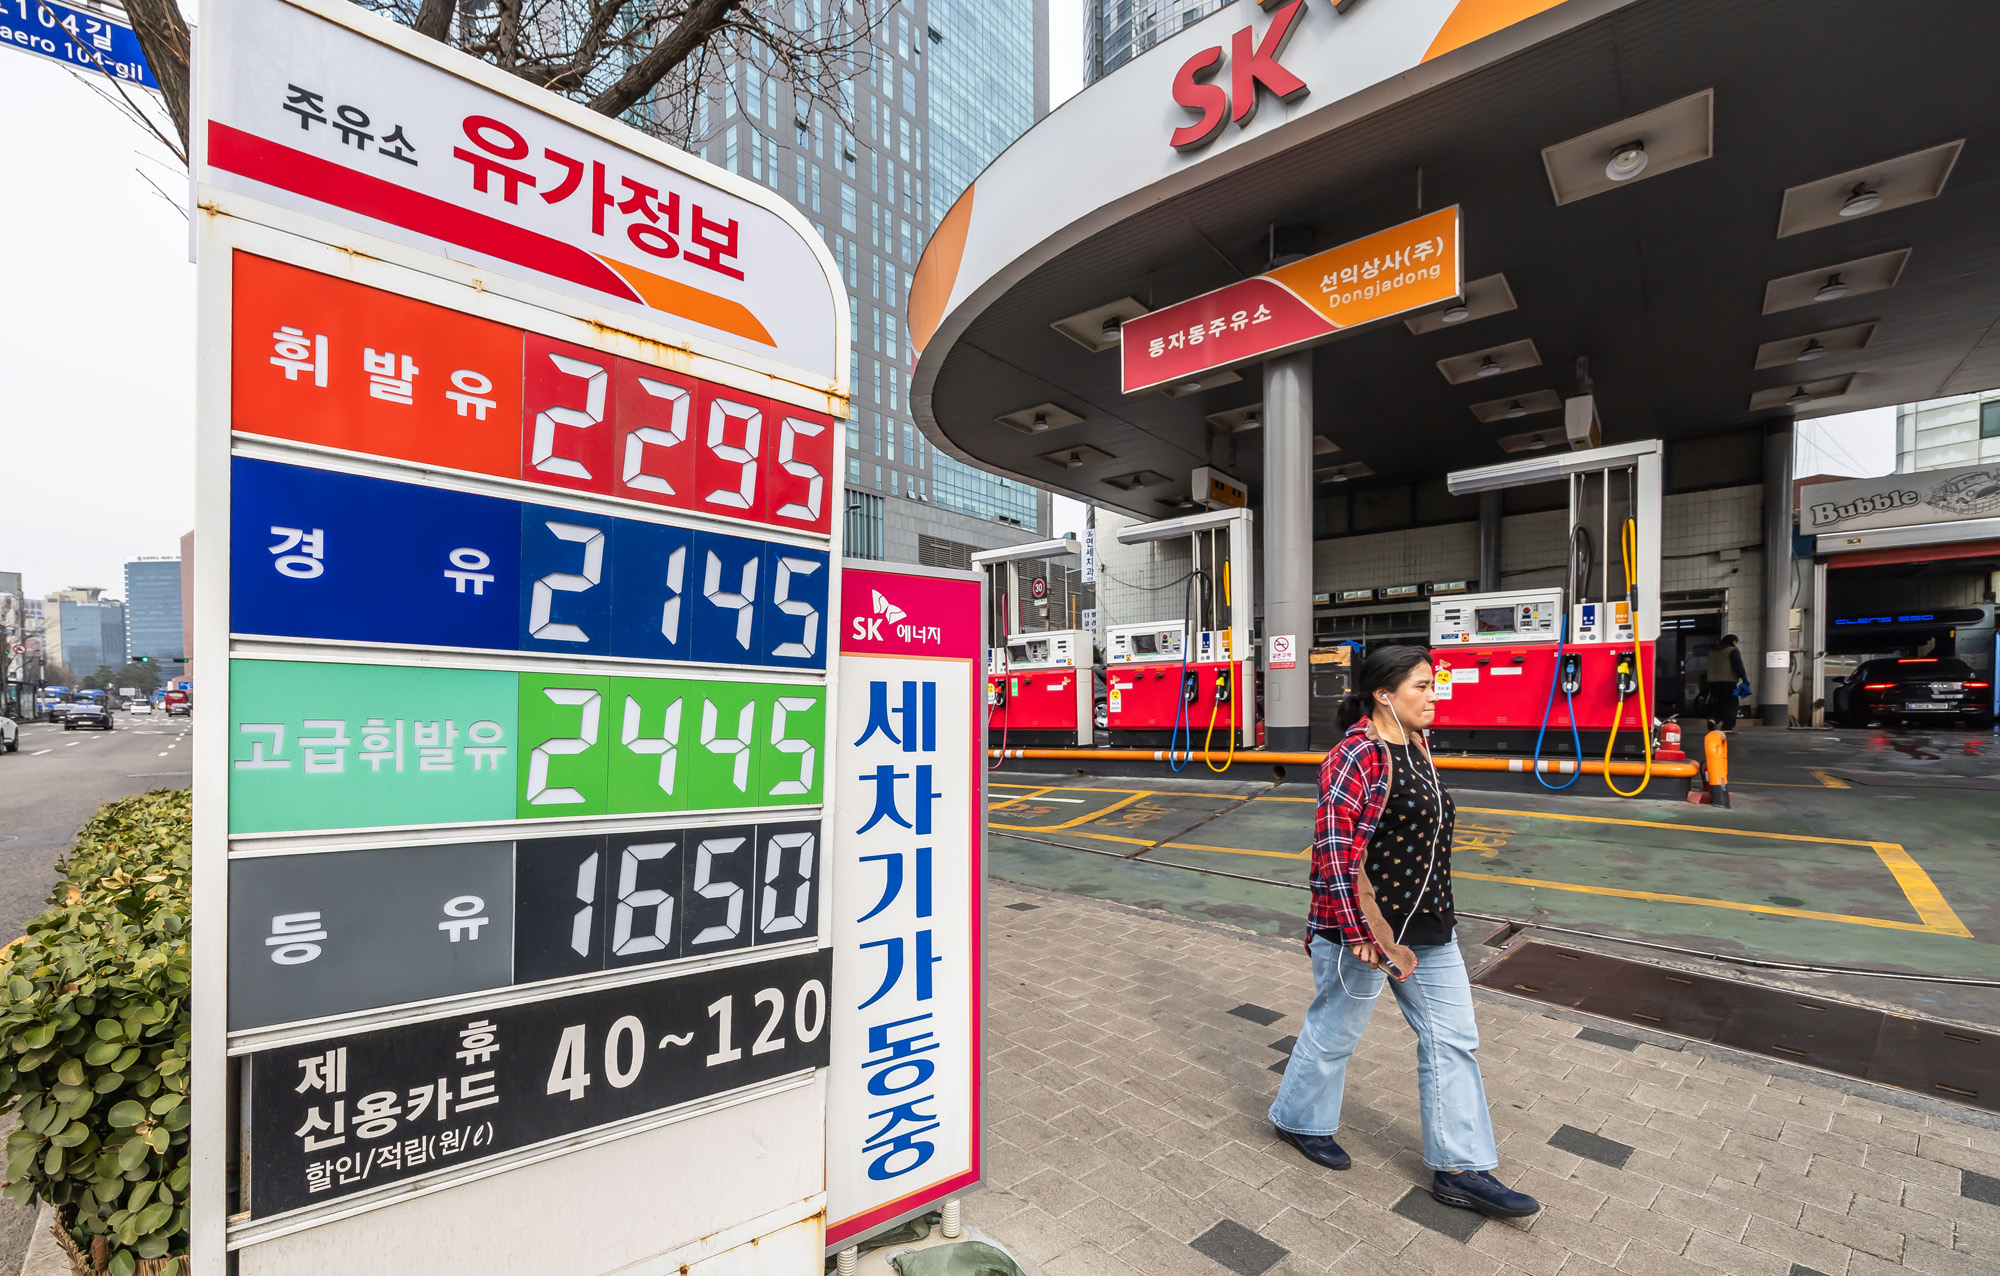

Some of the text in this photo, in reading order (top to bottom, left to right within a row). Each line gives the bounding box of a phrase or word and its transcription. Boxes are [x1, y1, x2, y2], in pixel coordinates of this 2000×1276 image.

[64, 42, 144, 82] 104-gil
[1169, 0, 1309, 150] SK
[282, 82, 745, 282] 주유소 유가정보
[1319, 236, 1444, 293] 선익상사(주)
[1328, 263, 1441, 309] Dongjadong
[1147, 303, 1272, 358] 동자동주유소
[270, 325, 826, 522] 휘발유 2295
[1811, 490, 1919, 528] Bubble
[529, 521, 822, 658] 2145
[1034, 583, 1043, 593] 30
[852, 616, 941, 645] SK 에너지
[233, 687, 818, 805] 고급휘발유 2445
[570, 832, 815, 958] 1650
[546, 979, 826, 1101] 40~120
[295, 1070, 499, 1153] 신용카드
